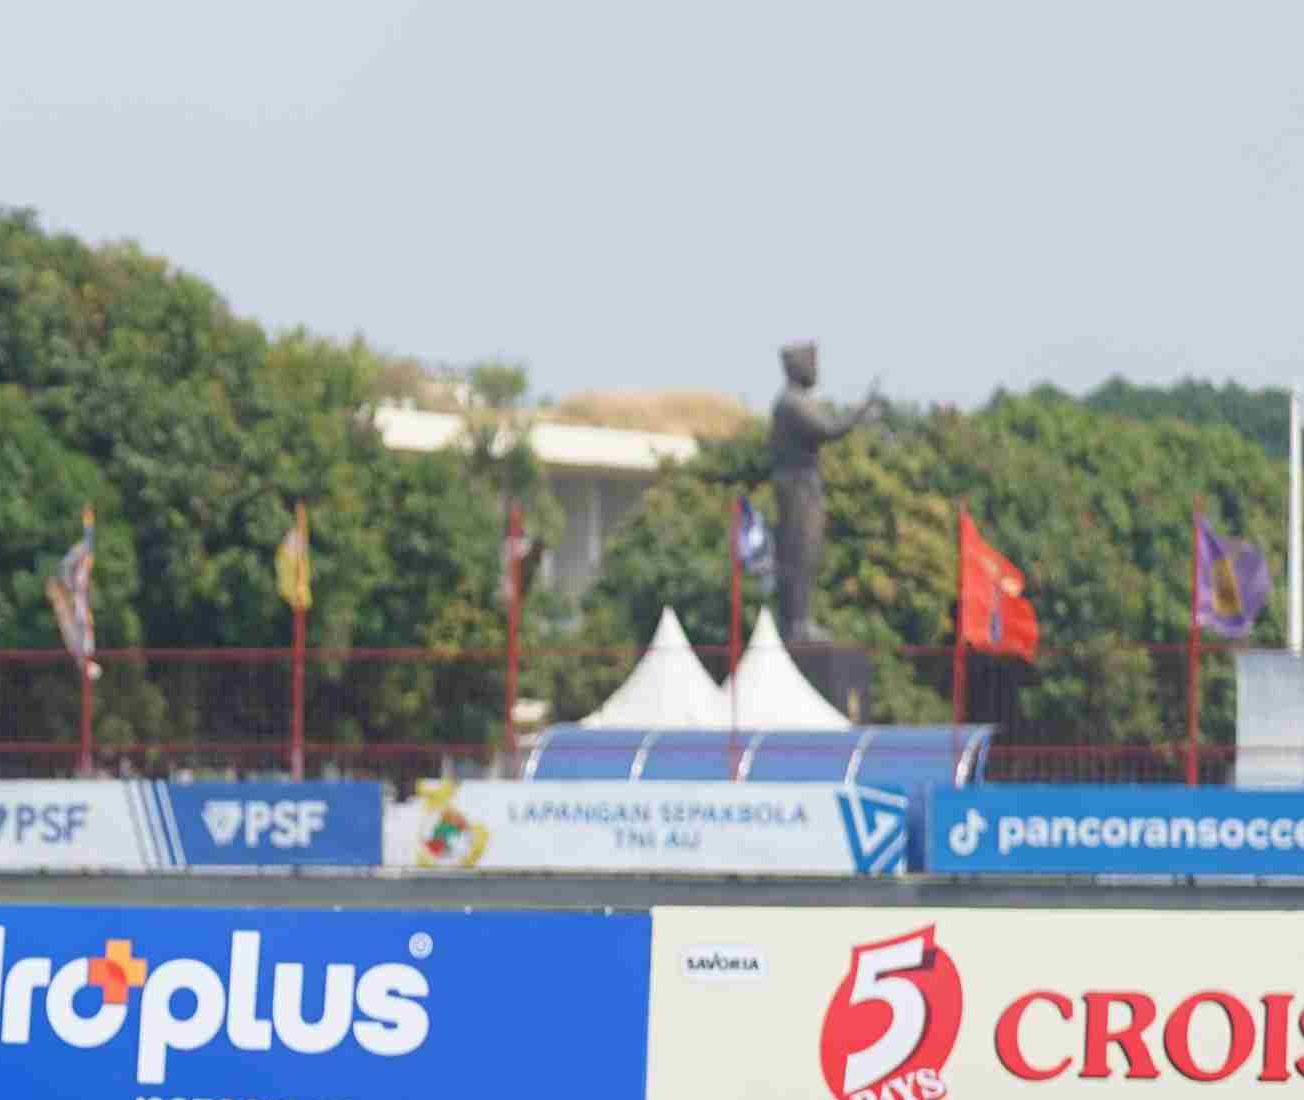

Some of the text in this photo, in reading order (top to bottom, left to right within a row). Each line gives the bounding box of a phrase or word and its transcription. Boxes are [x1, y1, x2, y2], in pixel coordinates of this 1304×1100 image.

[15, 803, 90, 843] PSF
[244, 800, 329, 848] PSF
[842, 935, 928, 1095] 5
[994, 990, 1304, 1083] CROI
